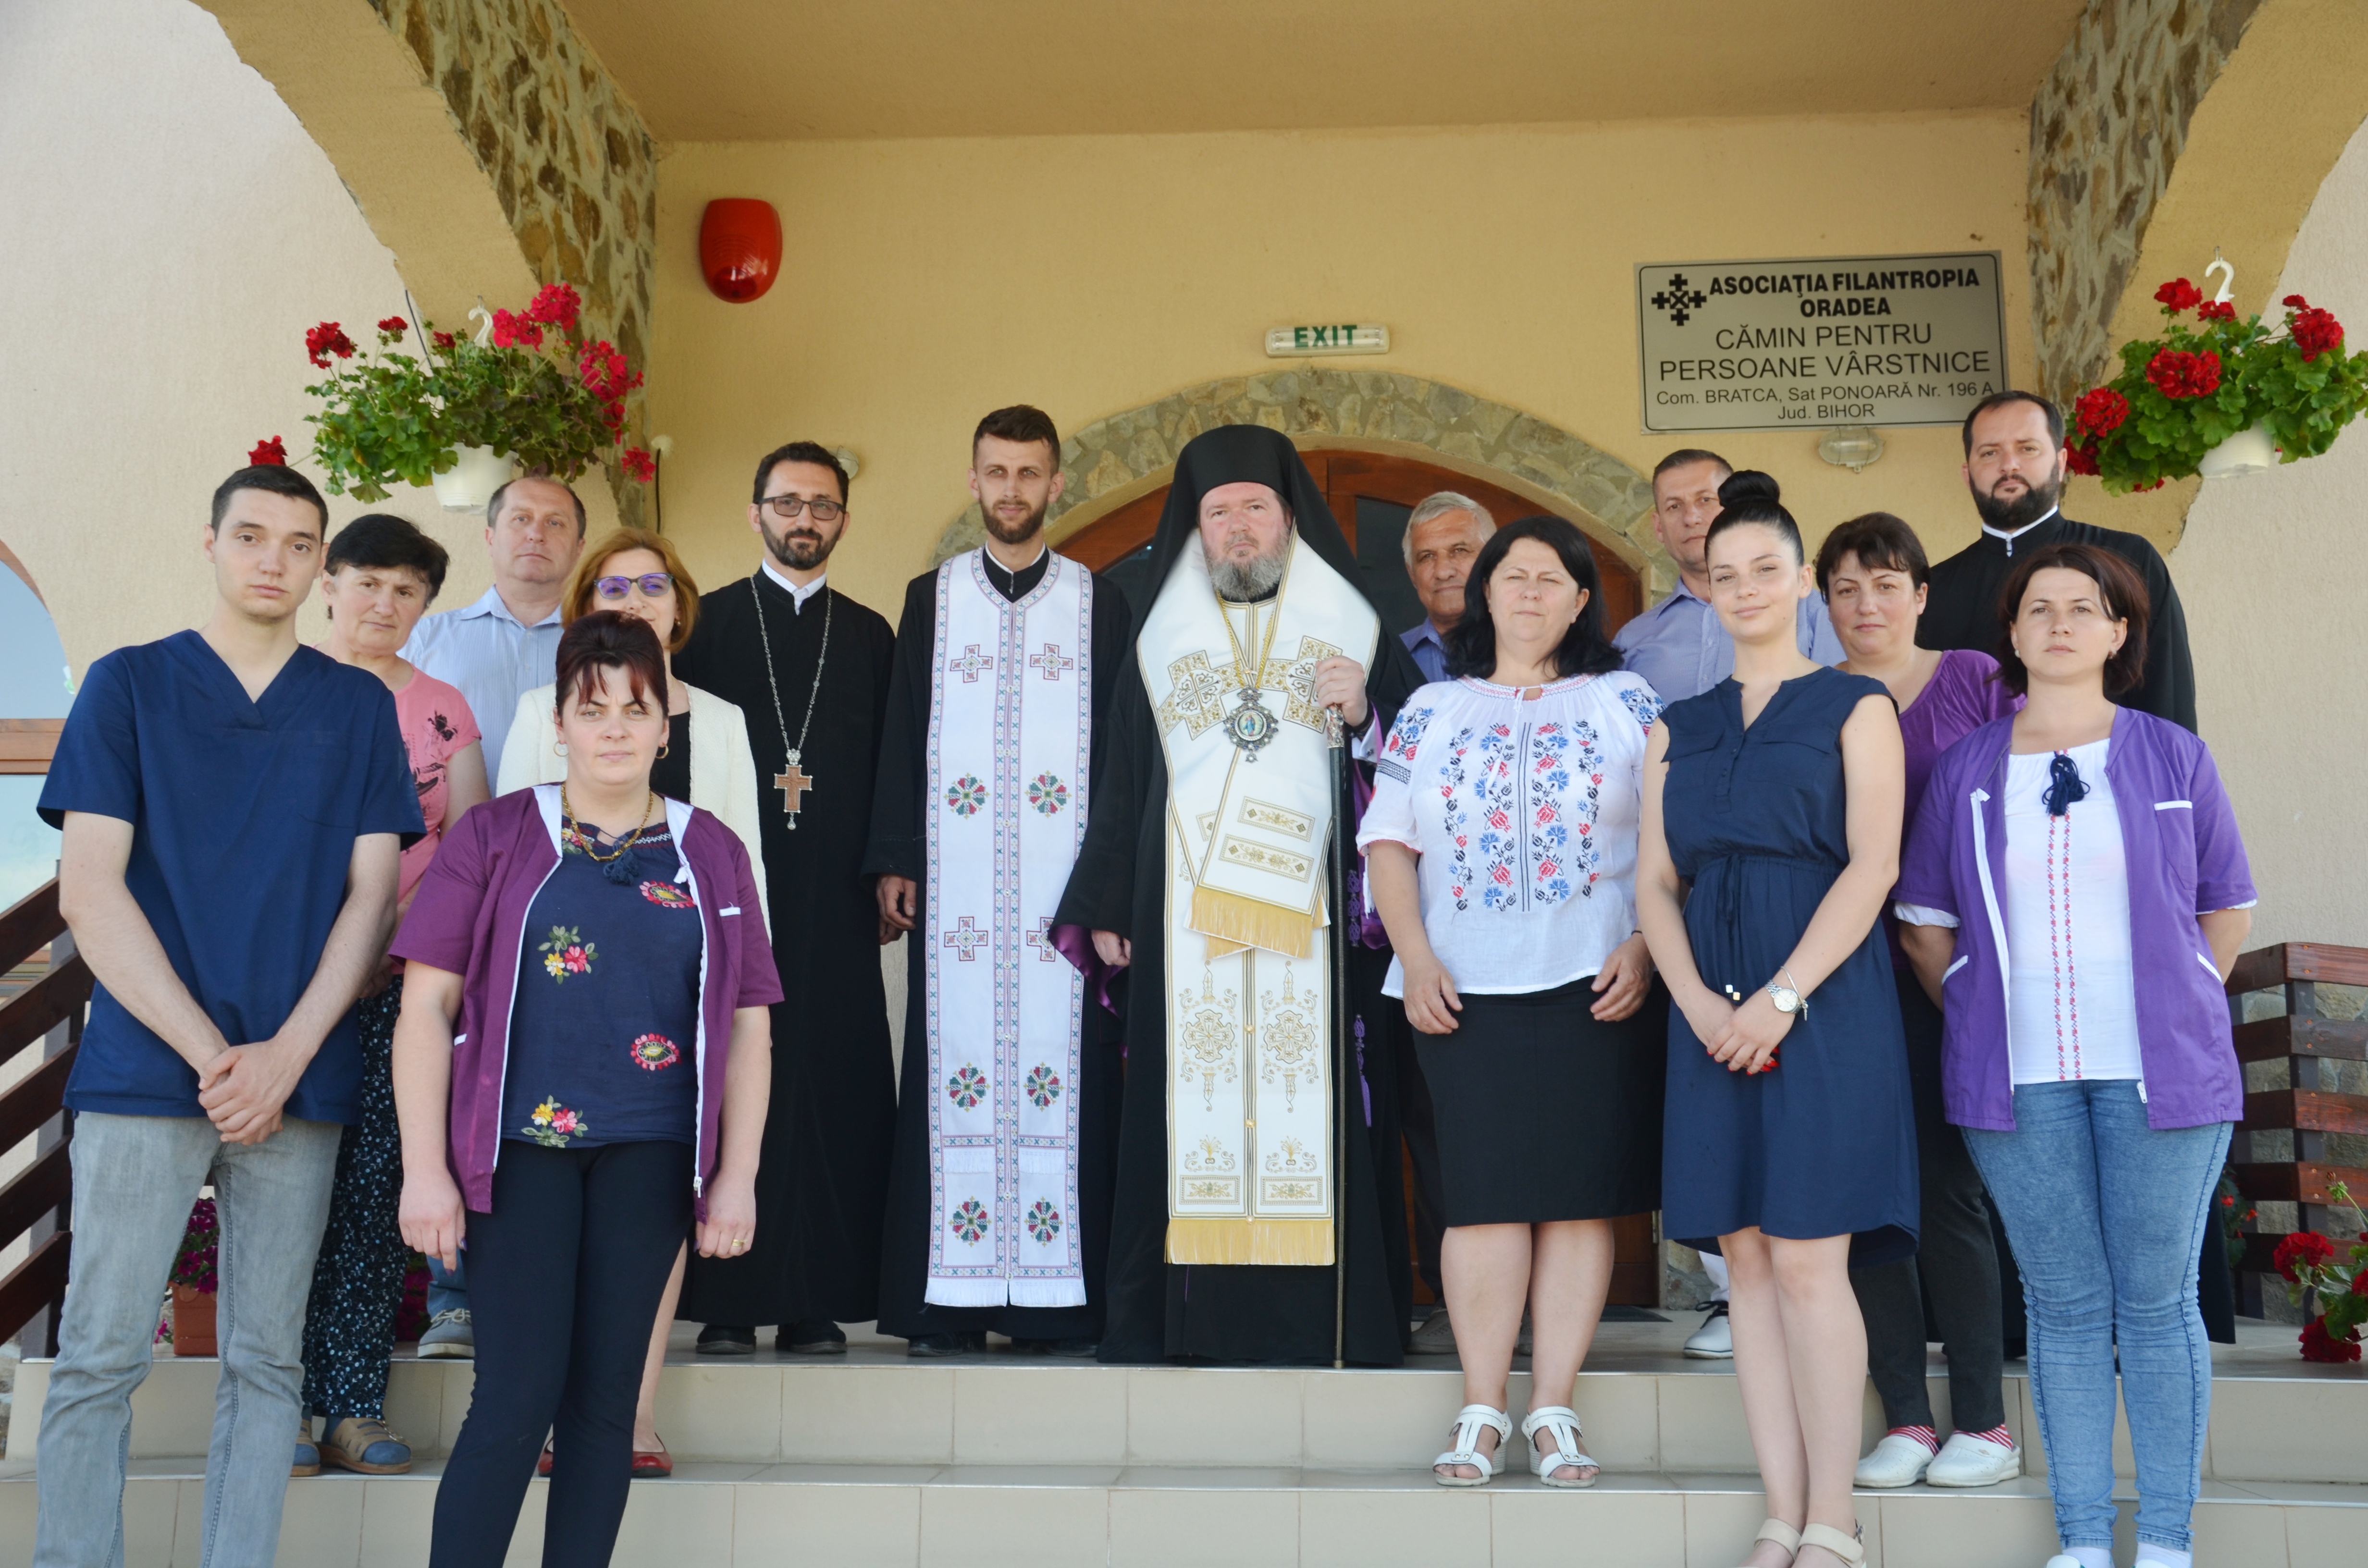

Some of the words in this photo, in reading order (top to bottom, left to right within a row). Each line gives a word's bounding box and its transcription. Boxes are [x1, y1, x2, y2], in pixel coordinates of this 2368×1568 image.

[1833, 269, 1979, 291] FILANTROPIA
[1801, 297, 1891, 318] ORADEA
[1294, 325, 1357, 348] EXIT
[1716, 324, 1805, 350] CĂMIN
[1816, 323, 1931, 346] PENTRU
[1660, 356, 1816, 381] PERSOANE
[1825, 351, 1990, 376] VÂRSTNICE
[1656, 390, 1699, 405] Com.
[1705, 388, 1782, 404] BRATCA,
[1788, 387, 1815, 401] Sat
[1821, 382, 1912, 400] PONOARĂ
[1918, 384, 1940, 398] Nr.
[1949, 382, 1977, 397] 196
[1982, 382, 1994, 396] A
[1778, 405, 1811, 420] Jud.
[1817, 404, 1875, 418] BIHOR
